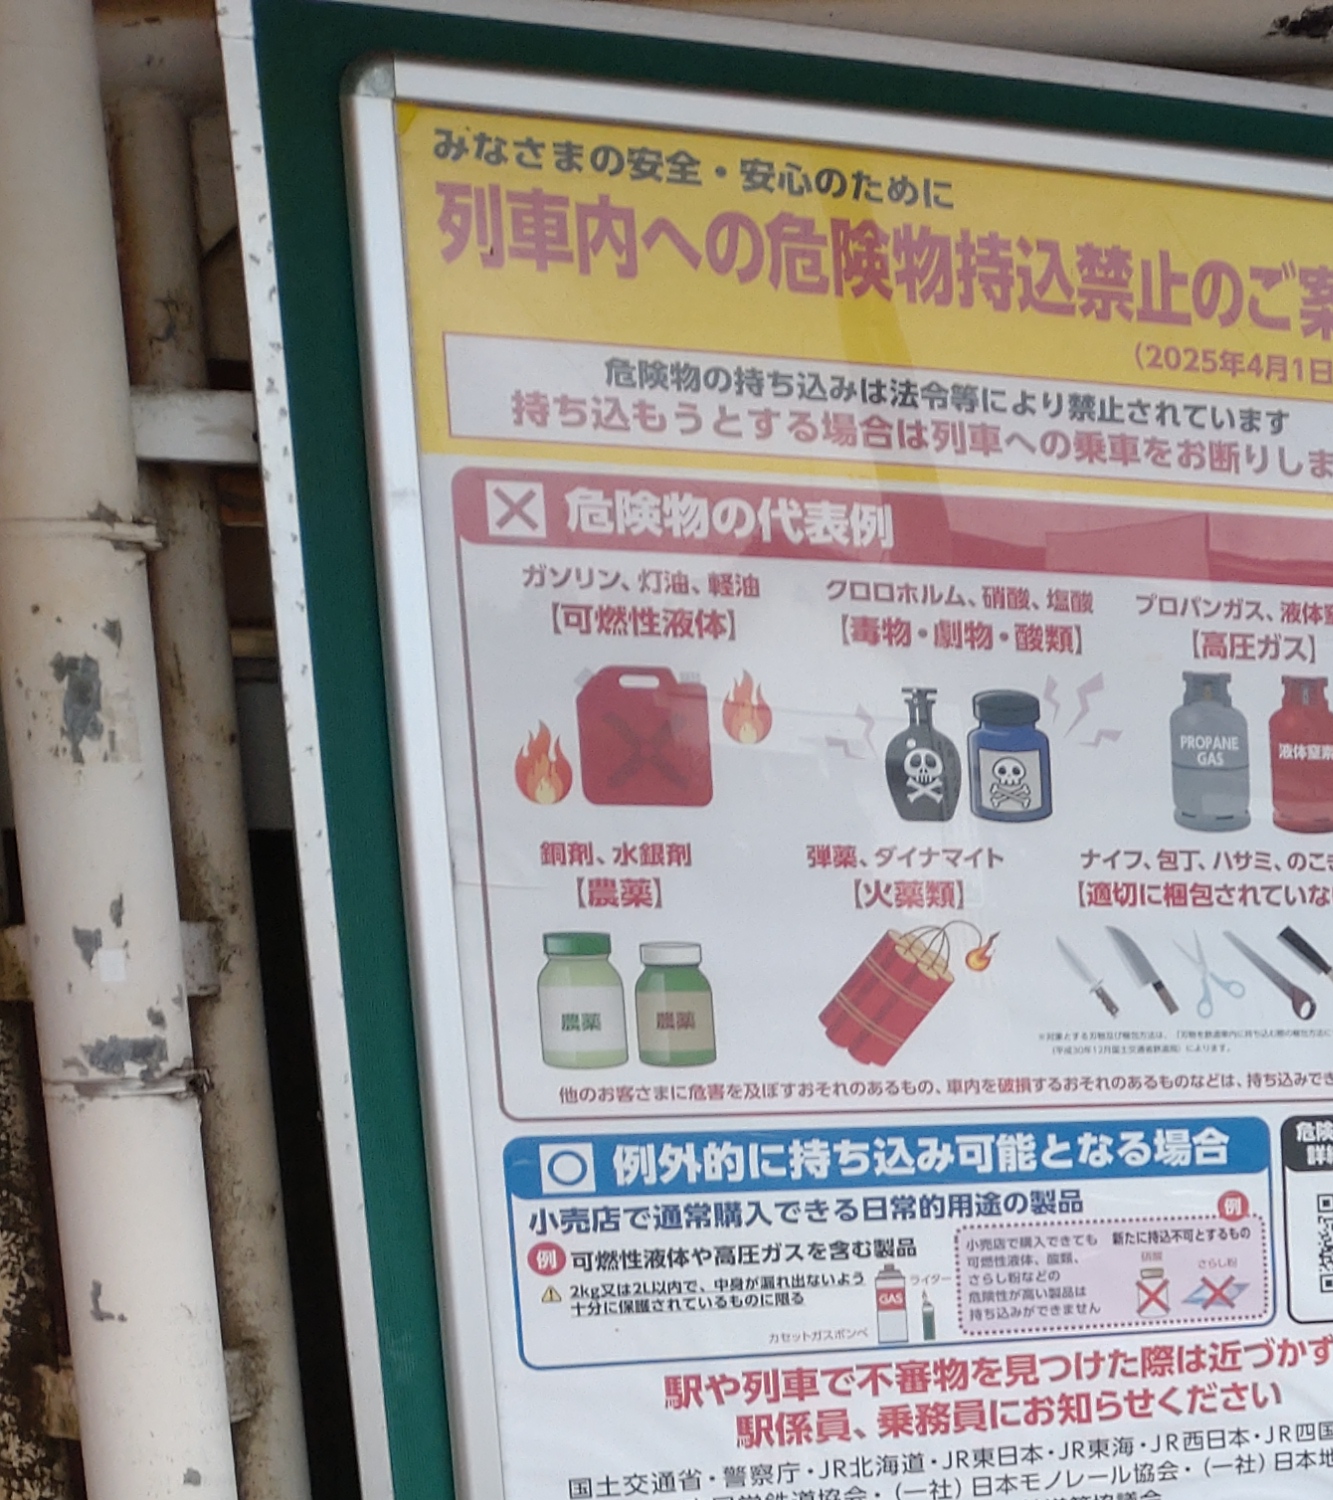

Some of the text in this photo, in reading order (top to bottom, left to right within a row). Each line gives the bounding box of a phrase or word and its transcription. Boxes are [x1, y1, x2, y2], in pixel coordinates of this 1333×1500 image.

[433, 126, 954, 209] みなさまの安全・安心のために
[604, 355, 1290, 433] 危険物の持ち込みは法令等により禁止されています
[565, 485, 895, 548] 危険物の代表例
[522, 565, 761, 598] ガソリン、灯油、軽油
[826, 578, 1094, 615] クロロホルム、硝酸、塩酸
[552, 603, 737, 641] 【可燃性液体】
[842, 615, 1083, 656] 【毒物・劇物・酸類】
[1193, 629, 1316, 663] 【高圧ガス】
[1180, 734, 1240, 753] PROPANE
[1197, 751, 1225, 768] GAS
[540, 841, 692, 868] 銅剤、水銀剤
[806, 843, 1004, 870] 弾薬、ダイナマイト
[576, 876, 662, 910] 【農薬】
[853, 878, 964, 910] 【火薬類】
[561, 1012, 602, 1032] 農薬
[656, 1010, 696, 1031] 農薬
[612, 1129, 1230, 1186] 例外的に持ち込み可能となる場合
[528, 1189, 1084, 1236] 小売店で通常購入できる日常的用途の製品
[1224, 1198, 1243, 1217] 例
[966, 1233, 1098, 1251] 小売店で購入できても
[1111, 1226, 1252, 1247] 新たに持込不可とするもの
[536, 1249, 558, 1270] 例
[571, 1237, 918, 1273] 可燃性液体や高圧ガスを含む製品
[968, 1268, 1061, 1285] さらし粉などの
[571, 1291, 804, 1317] 十分に保護されているものに限る
[878, 1292, 905, 1305] GAS
[968, 1285, 1087, 1303] 危険性が高い製品は
[969, 1302, 1101, 1321] 持ち込みができません
[736, 1381, 1283, 1449] 駅係員、乗務員にお知らせください
